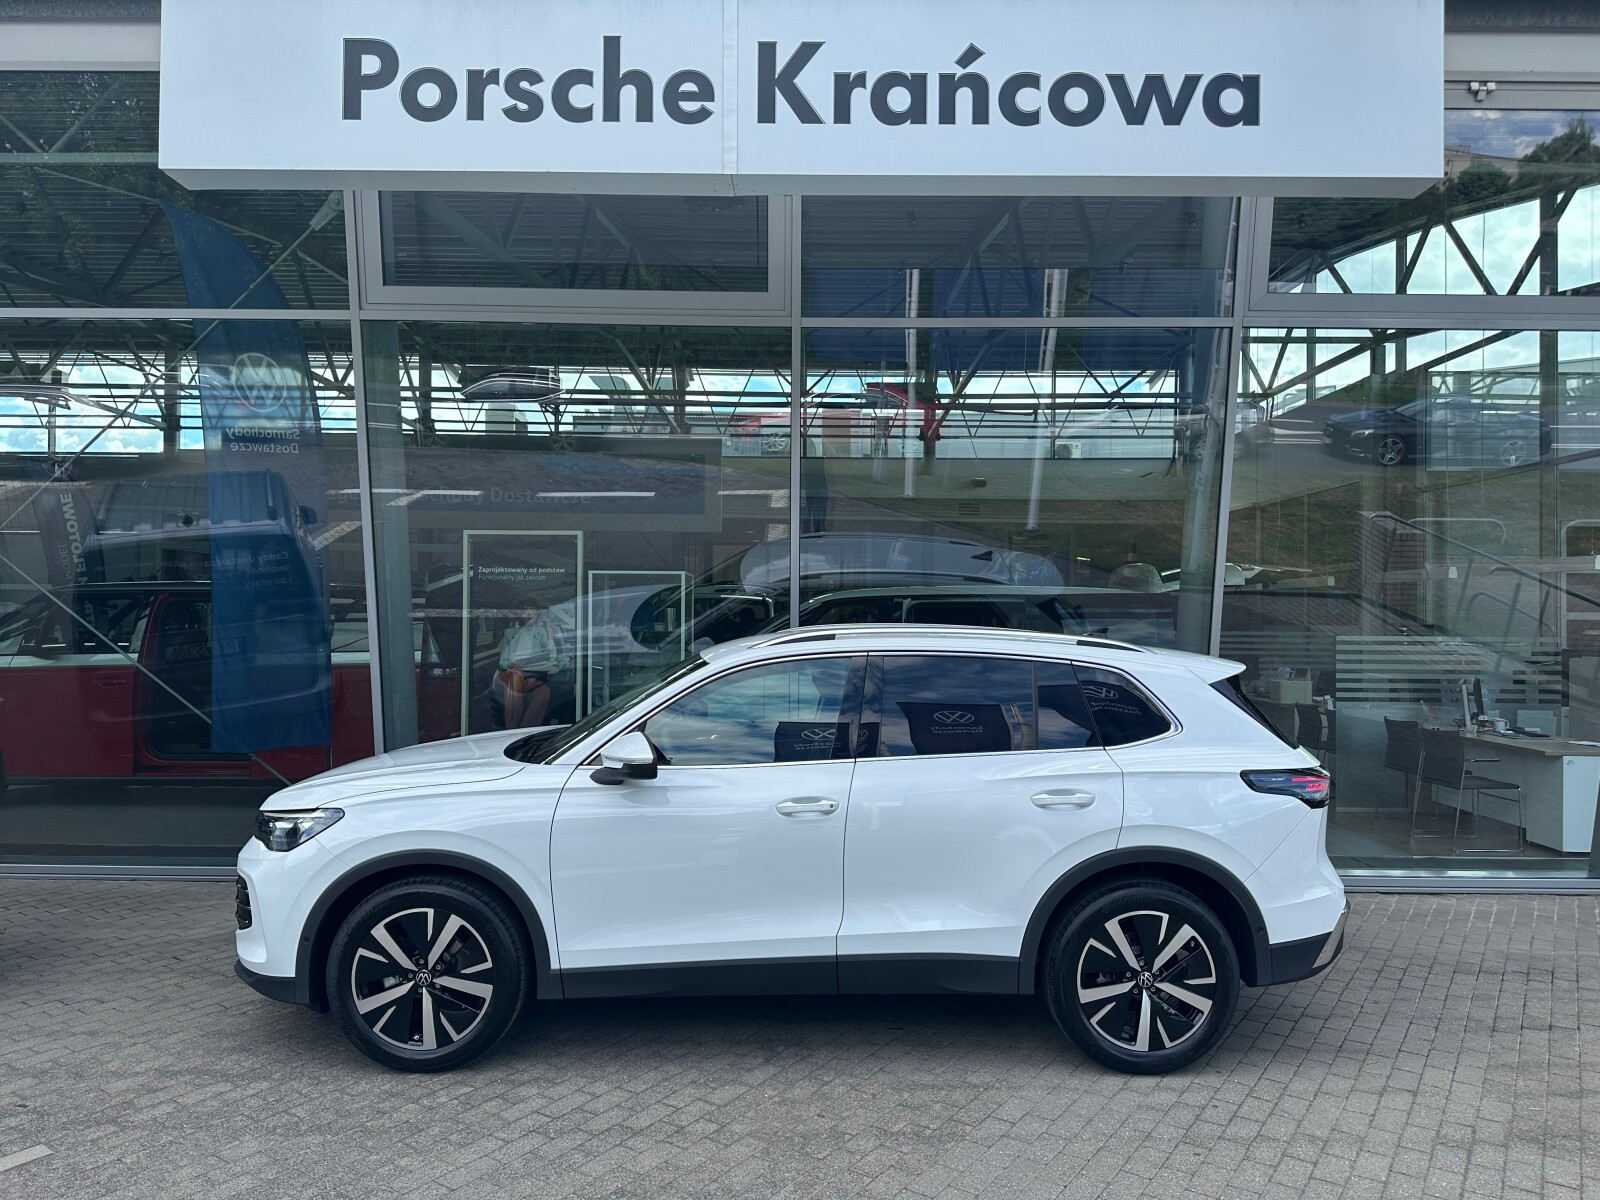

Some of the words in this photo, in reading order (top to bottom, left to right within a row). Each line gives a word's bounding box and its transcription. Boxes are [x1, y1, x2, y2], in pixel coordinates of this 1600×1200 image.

[341, 35, 716, 125] Porsche
[756, 42, 1261, 127] Krańcowa
[478, 566, 527, 575] Zaprojektowany
[538, 566, 565, 575] podstaw
